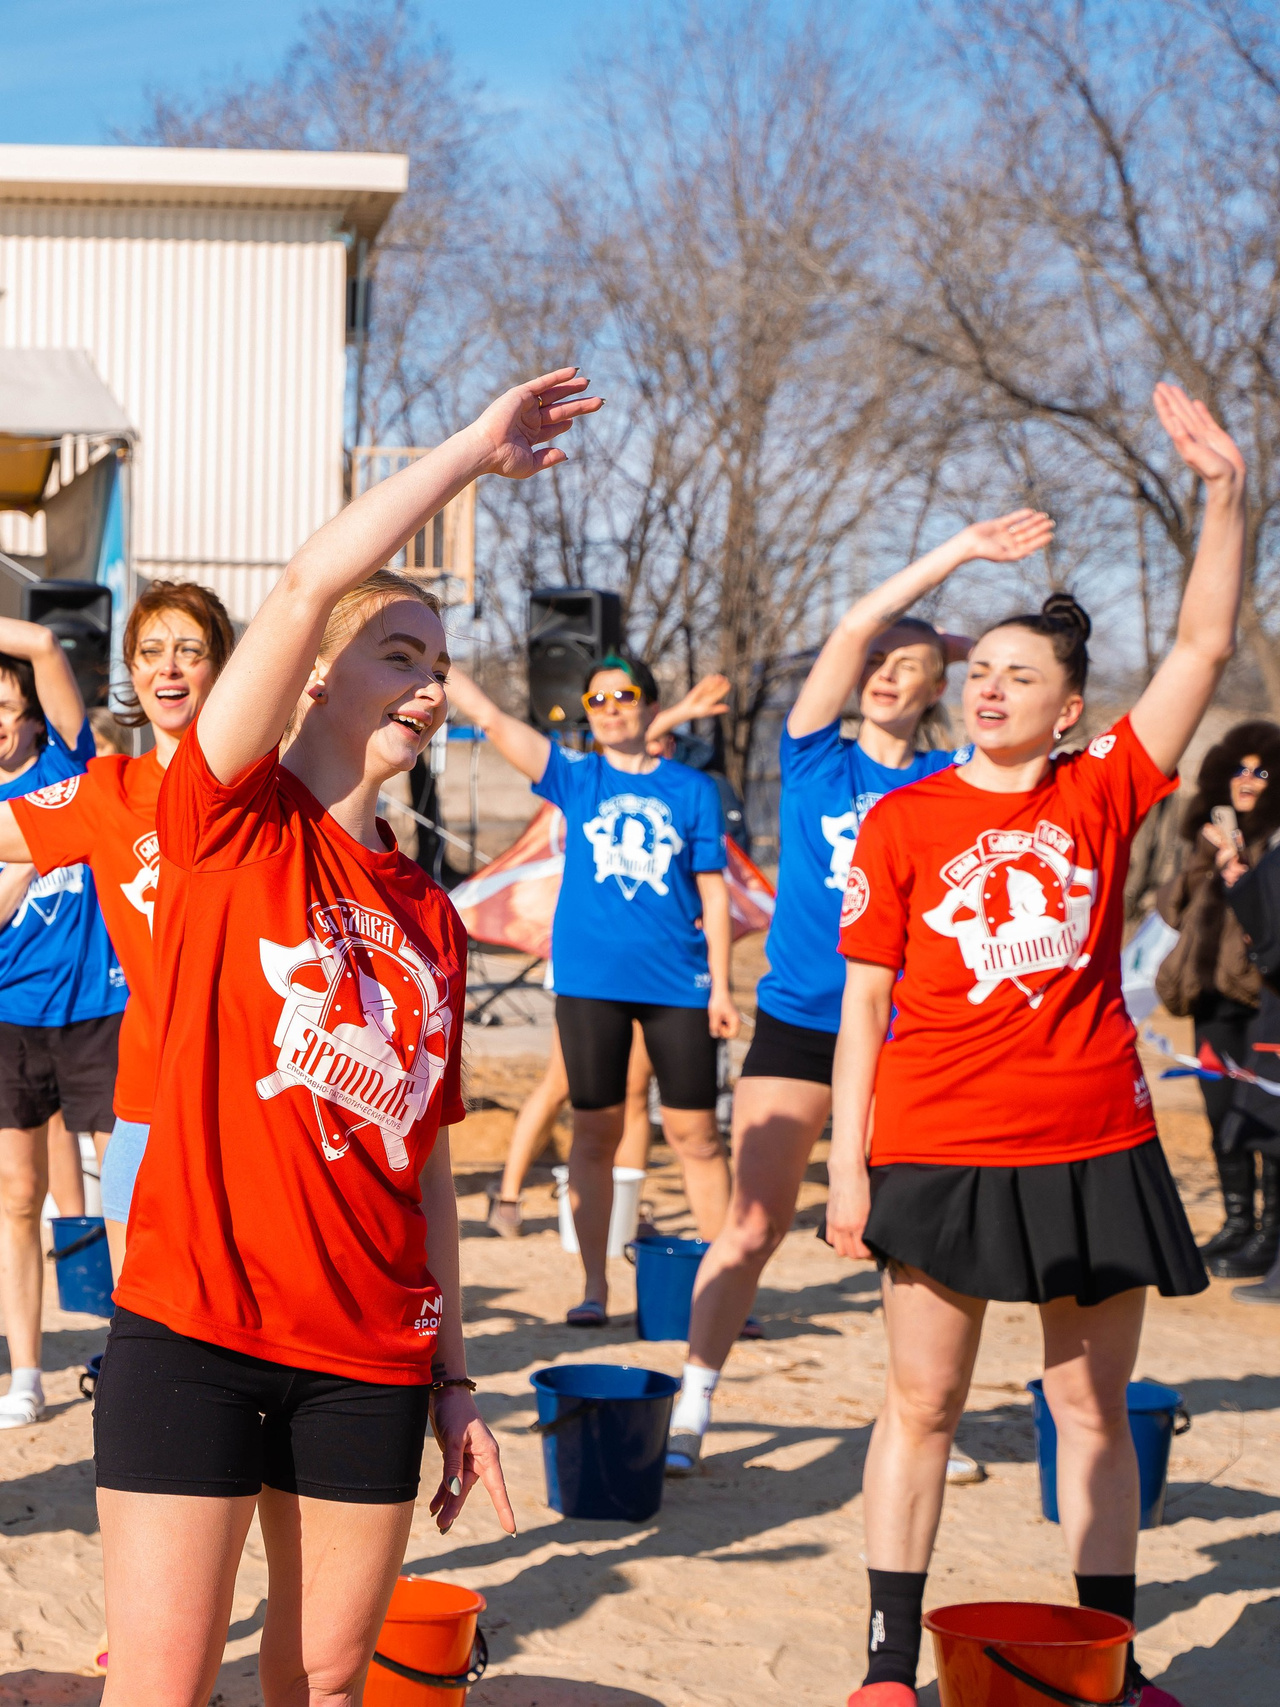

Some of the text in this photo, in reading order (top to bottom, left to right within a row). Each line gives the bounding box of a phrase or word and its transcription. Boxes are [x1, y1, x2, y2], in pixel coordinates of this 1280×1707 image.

[340, 905, 395, 949] СЛАВА
[286, 1062, 403, 1130] СПОРТИВНО-ПАТРИОТИЧЕСКИЙ КЛУБ
[291, 1028, 417, 1121] ЯРОПОЛК
